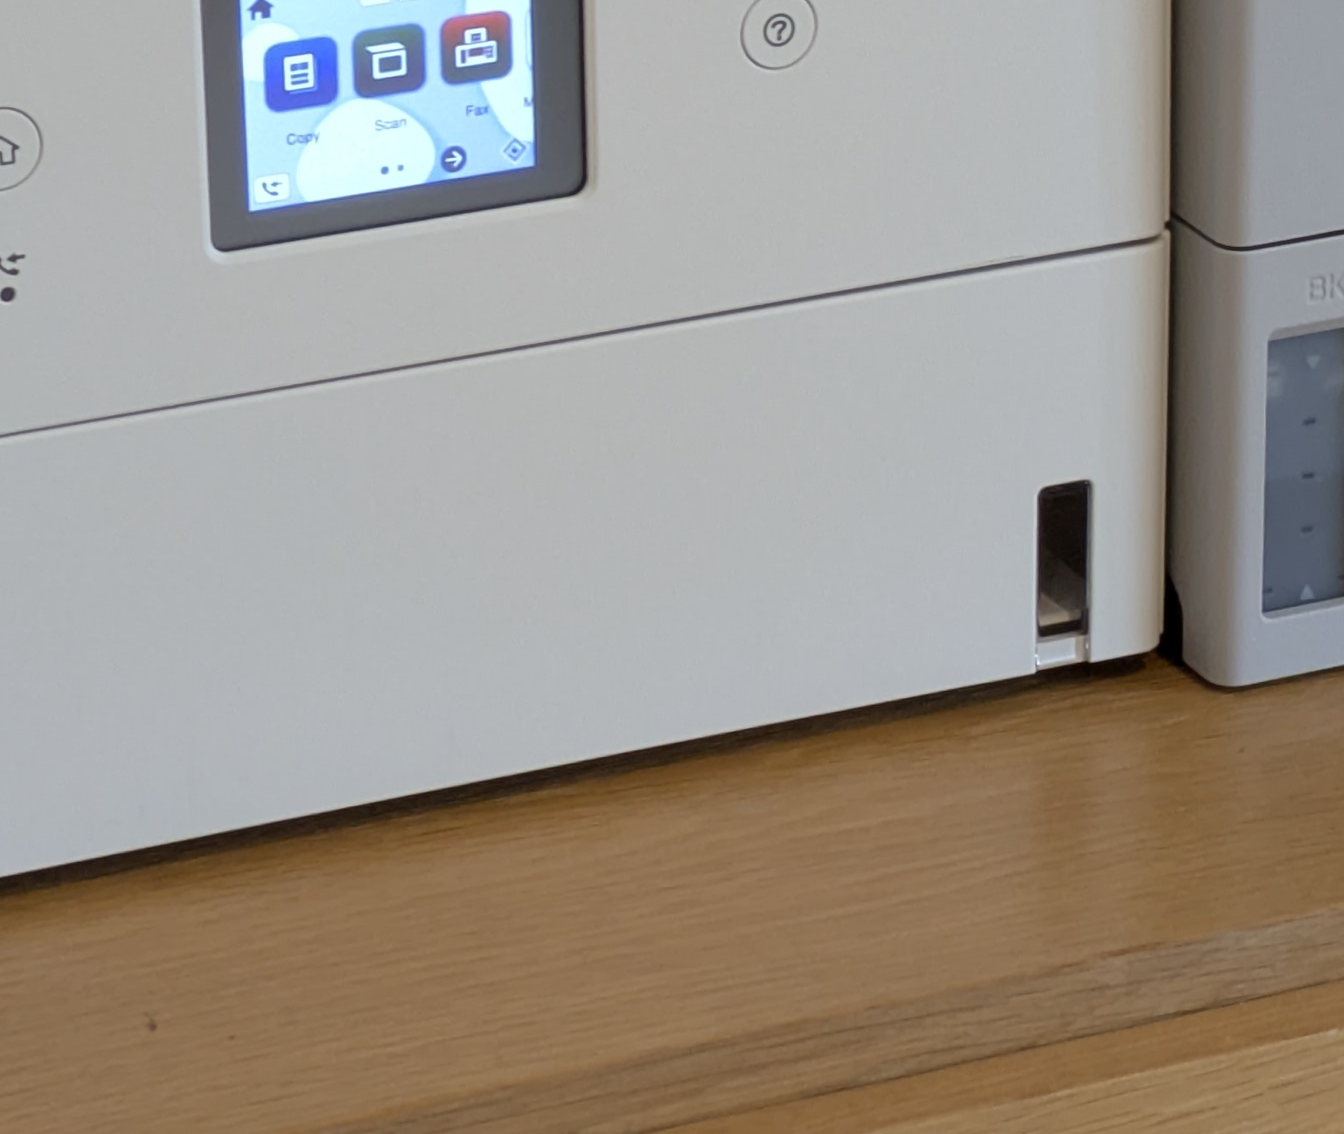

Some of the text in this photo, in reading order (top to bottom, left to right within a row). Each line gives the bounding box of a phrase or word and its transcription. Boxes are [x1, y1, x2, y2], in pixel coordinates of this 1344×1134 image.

[465, 104, 489, 117] Fax
[375, 118, 407, 132] Scan
[286, 131, 320, 147] Copy
